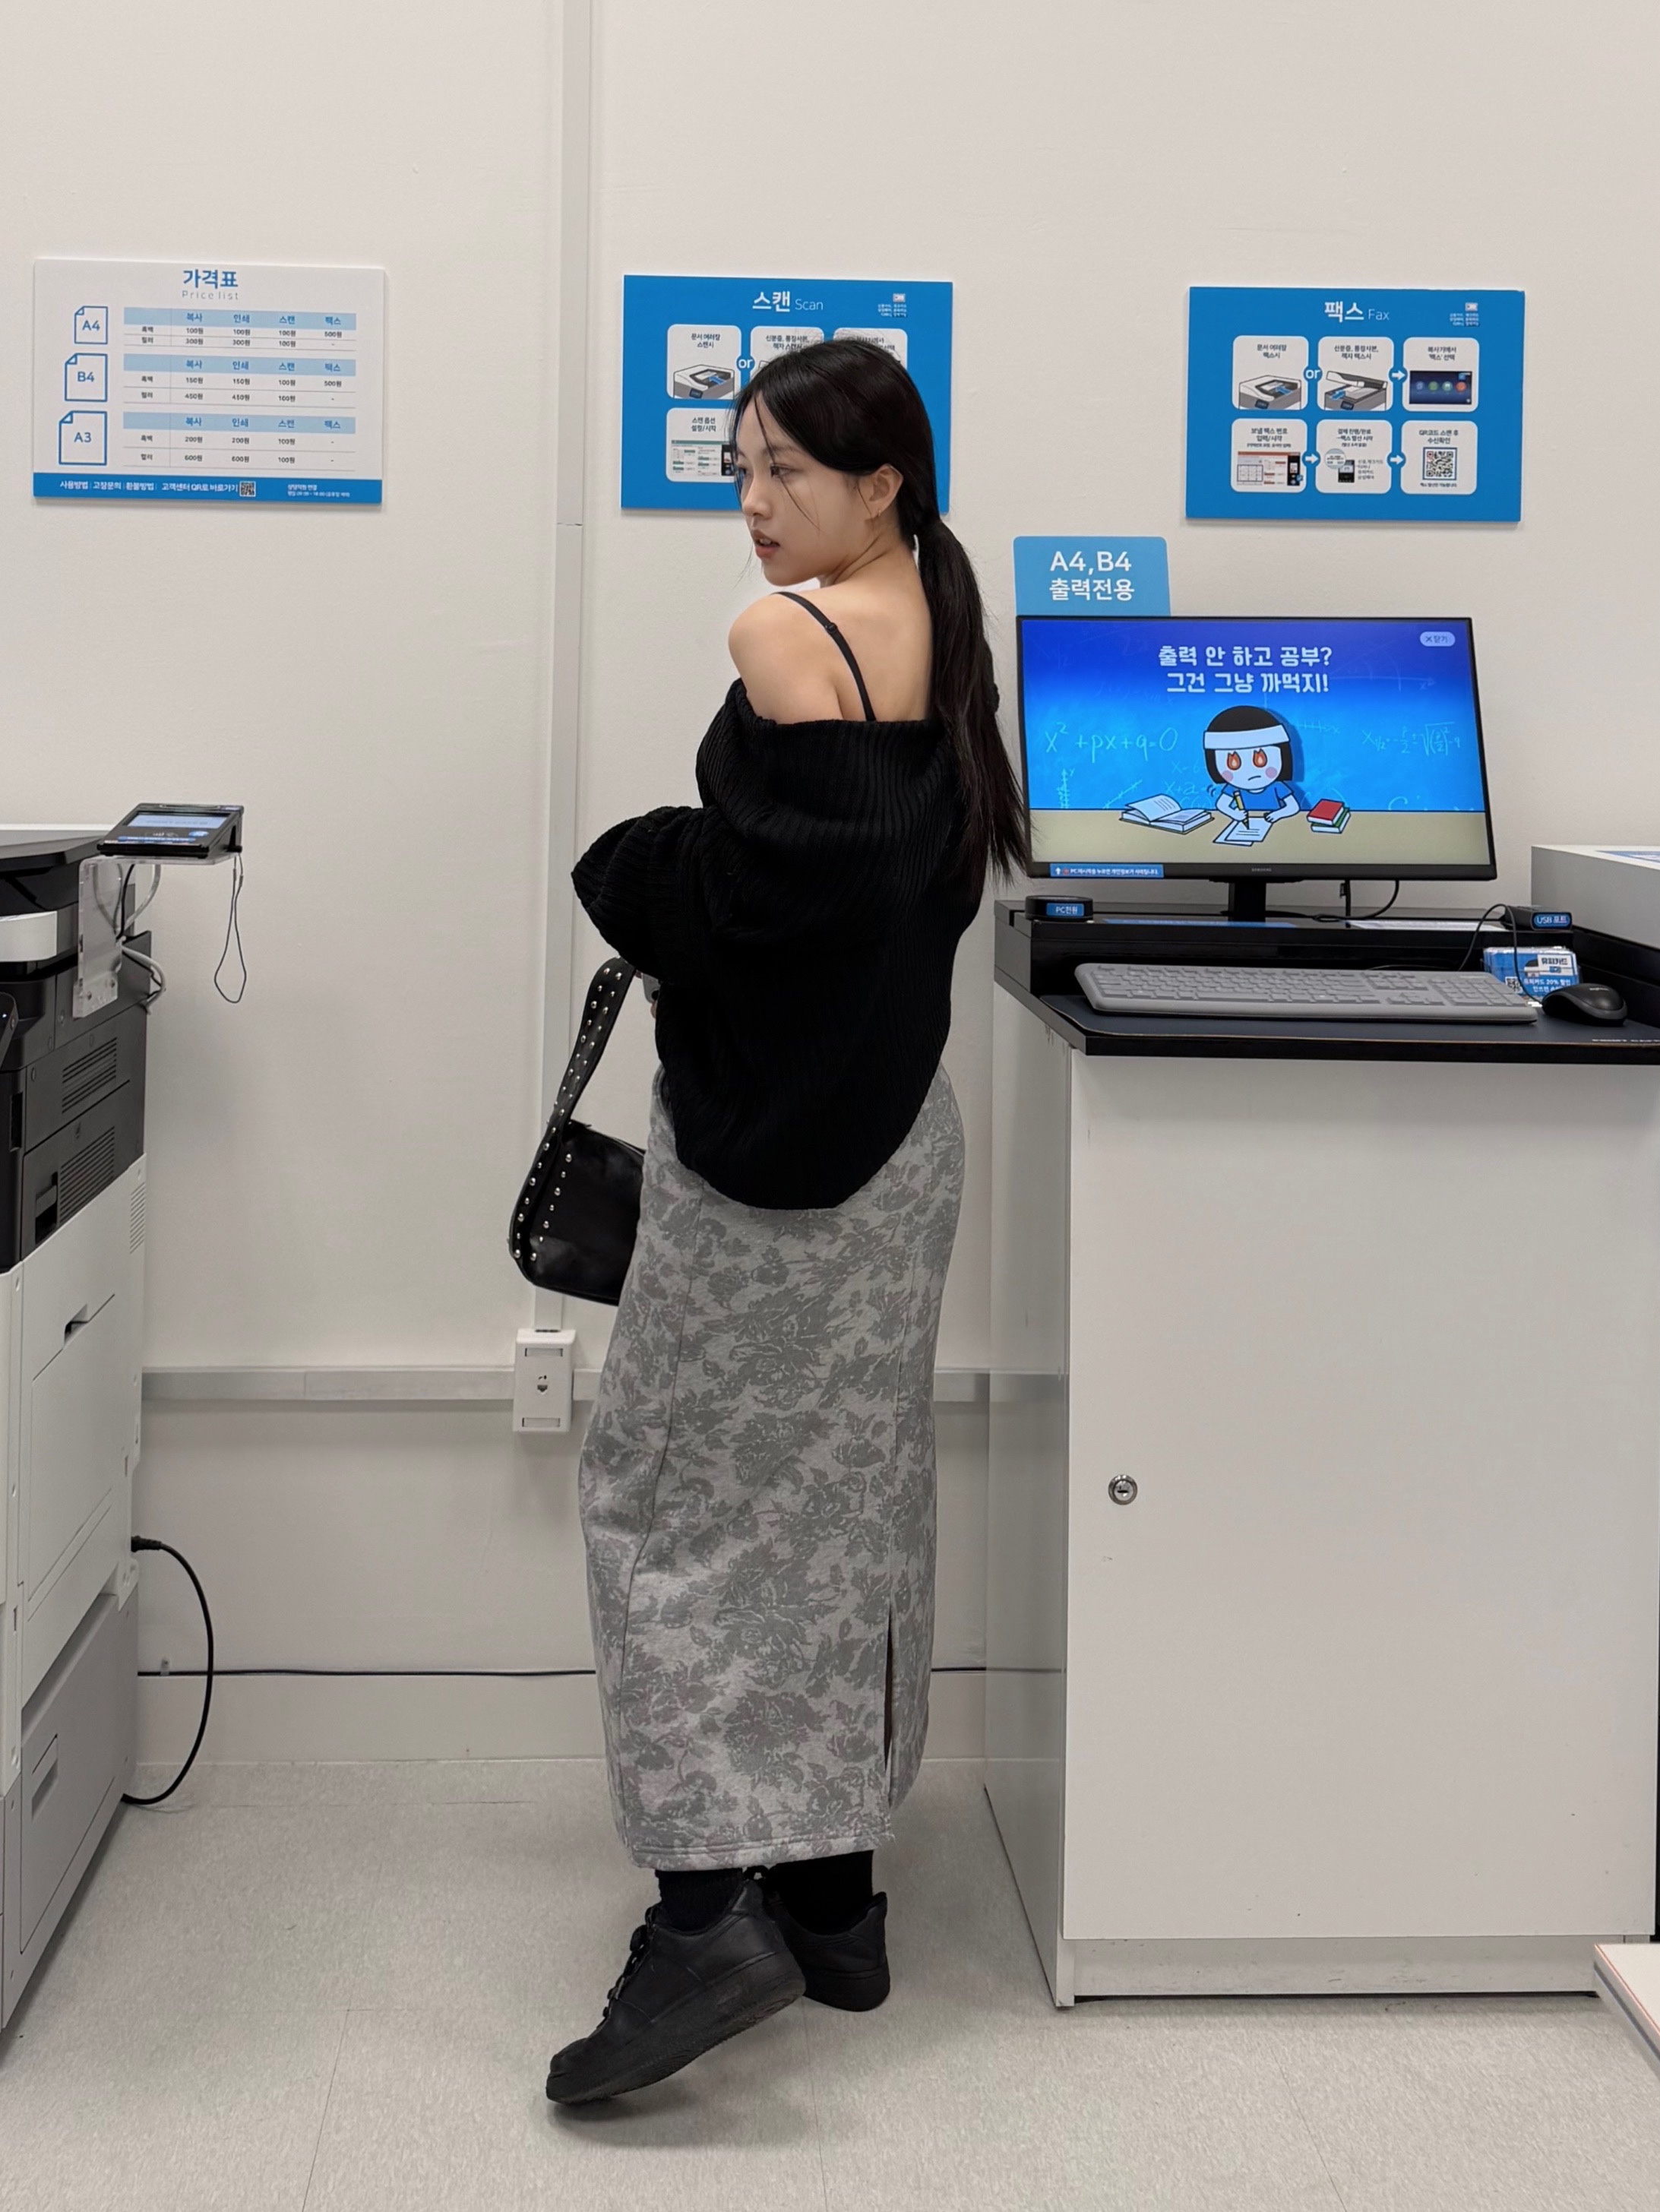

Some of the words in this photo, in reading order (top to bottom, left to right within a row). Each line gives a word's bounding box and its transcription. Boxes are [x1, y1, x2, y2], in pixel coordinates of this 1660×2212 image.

[183, 269, 239, 289] 가격표
[182, 290, 214, 299] Price
[218, 290, 239, 300] list
[752, 290, 791, 312] 스캔
[795, 299, 824, 311] Scan
[1324, 301, 1364, 323] 팩스
[1368, 309, 1390, 321] Fax
[186, 313, 202, 322] 복사
[233, 315, 250, 324] 인쇄
[279, 316, 295, 325] 스캔
[325, 316, 340, 325] 팩스
[82, 321, 100, 331] A4
[185, 360, 202, 369] 복사
[232, 361, 249, 371] 인쇄
[278, 362, 295, 371] 스캔
[325, 363, 340, 372] 팩스
[738, 359, 752, 369] or
[77, 371, 94, 382] B4
[1305, 369, 1320, 379] or
[185, 417, 202, 426] 복사
[232, 418, 249, 427] 인쇄
[278, 419, 295, 429] 스캔
[324, 420, 340, 429] 팩스
[74, 432, 91, 442] A3
[1049, 550, 1133, 575] A4,B4
[1049, 578, 1135, 601] 출력전용
[1434, 635, 1448, 644] 닫기
[1158, 645, 1197, 667] 출력
[1205, 646, 1226, 667] 안
[1232, 646, 1273, 667] 하고
[1279, 646, 1333, 667] 공부?
[1167, 672, 1206, 693] 그건
[1214, 672, 1254, 693] 그냥
[1260, 672, 1330, 693] 까먹지!
[1056, 906, 1077, 914] PC전원
[1536, 915, 1552, 924] USB
